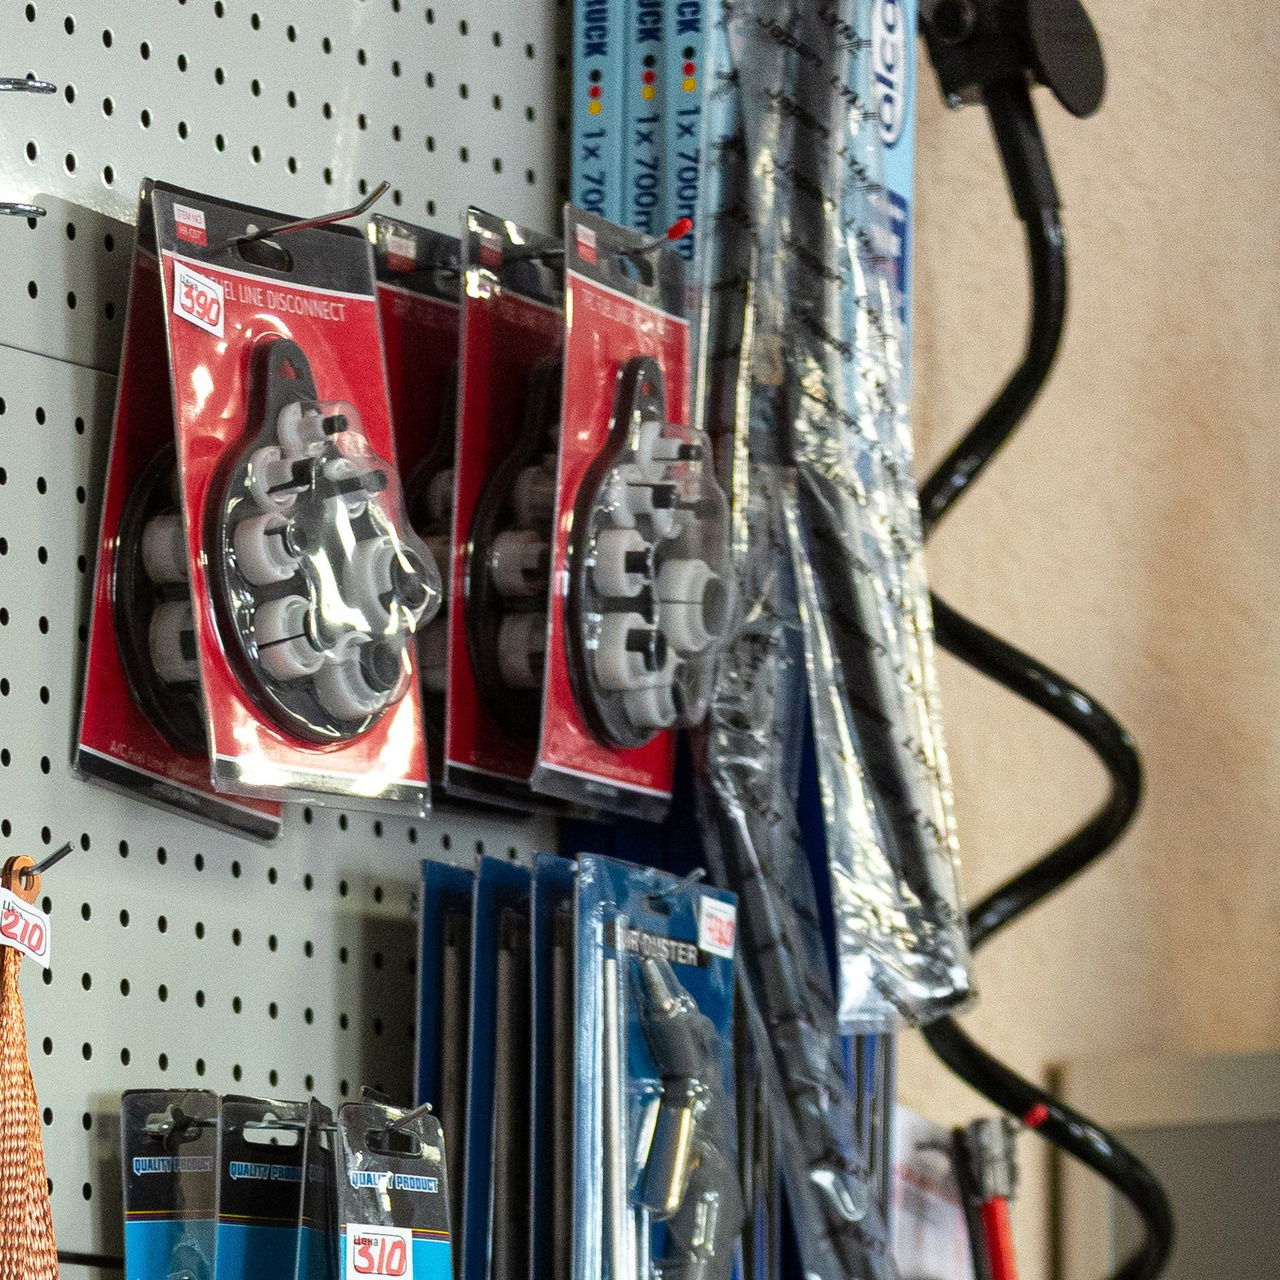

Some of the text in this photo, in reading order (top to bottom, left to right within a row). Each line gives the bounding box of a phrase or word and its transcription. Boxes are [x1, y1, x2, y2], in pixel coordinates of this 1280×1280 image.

[182, 284, 220, 326] 390
[238, 283, 264, 307] LINE
[267, 290, 346, 322] DISCONNECT
[0, 909, 44, 952] 210
[133, 1156, 170, 1175] QUALITY
[230, 1161, 270, 1180] QUALITY
[395, 1174, 439, 1194] PRODUCT
[354, 1238, 405, 1276] 310
